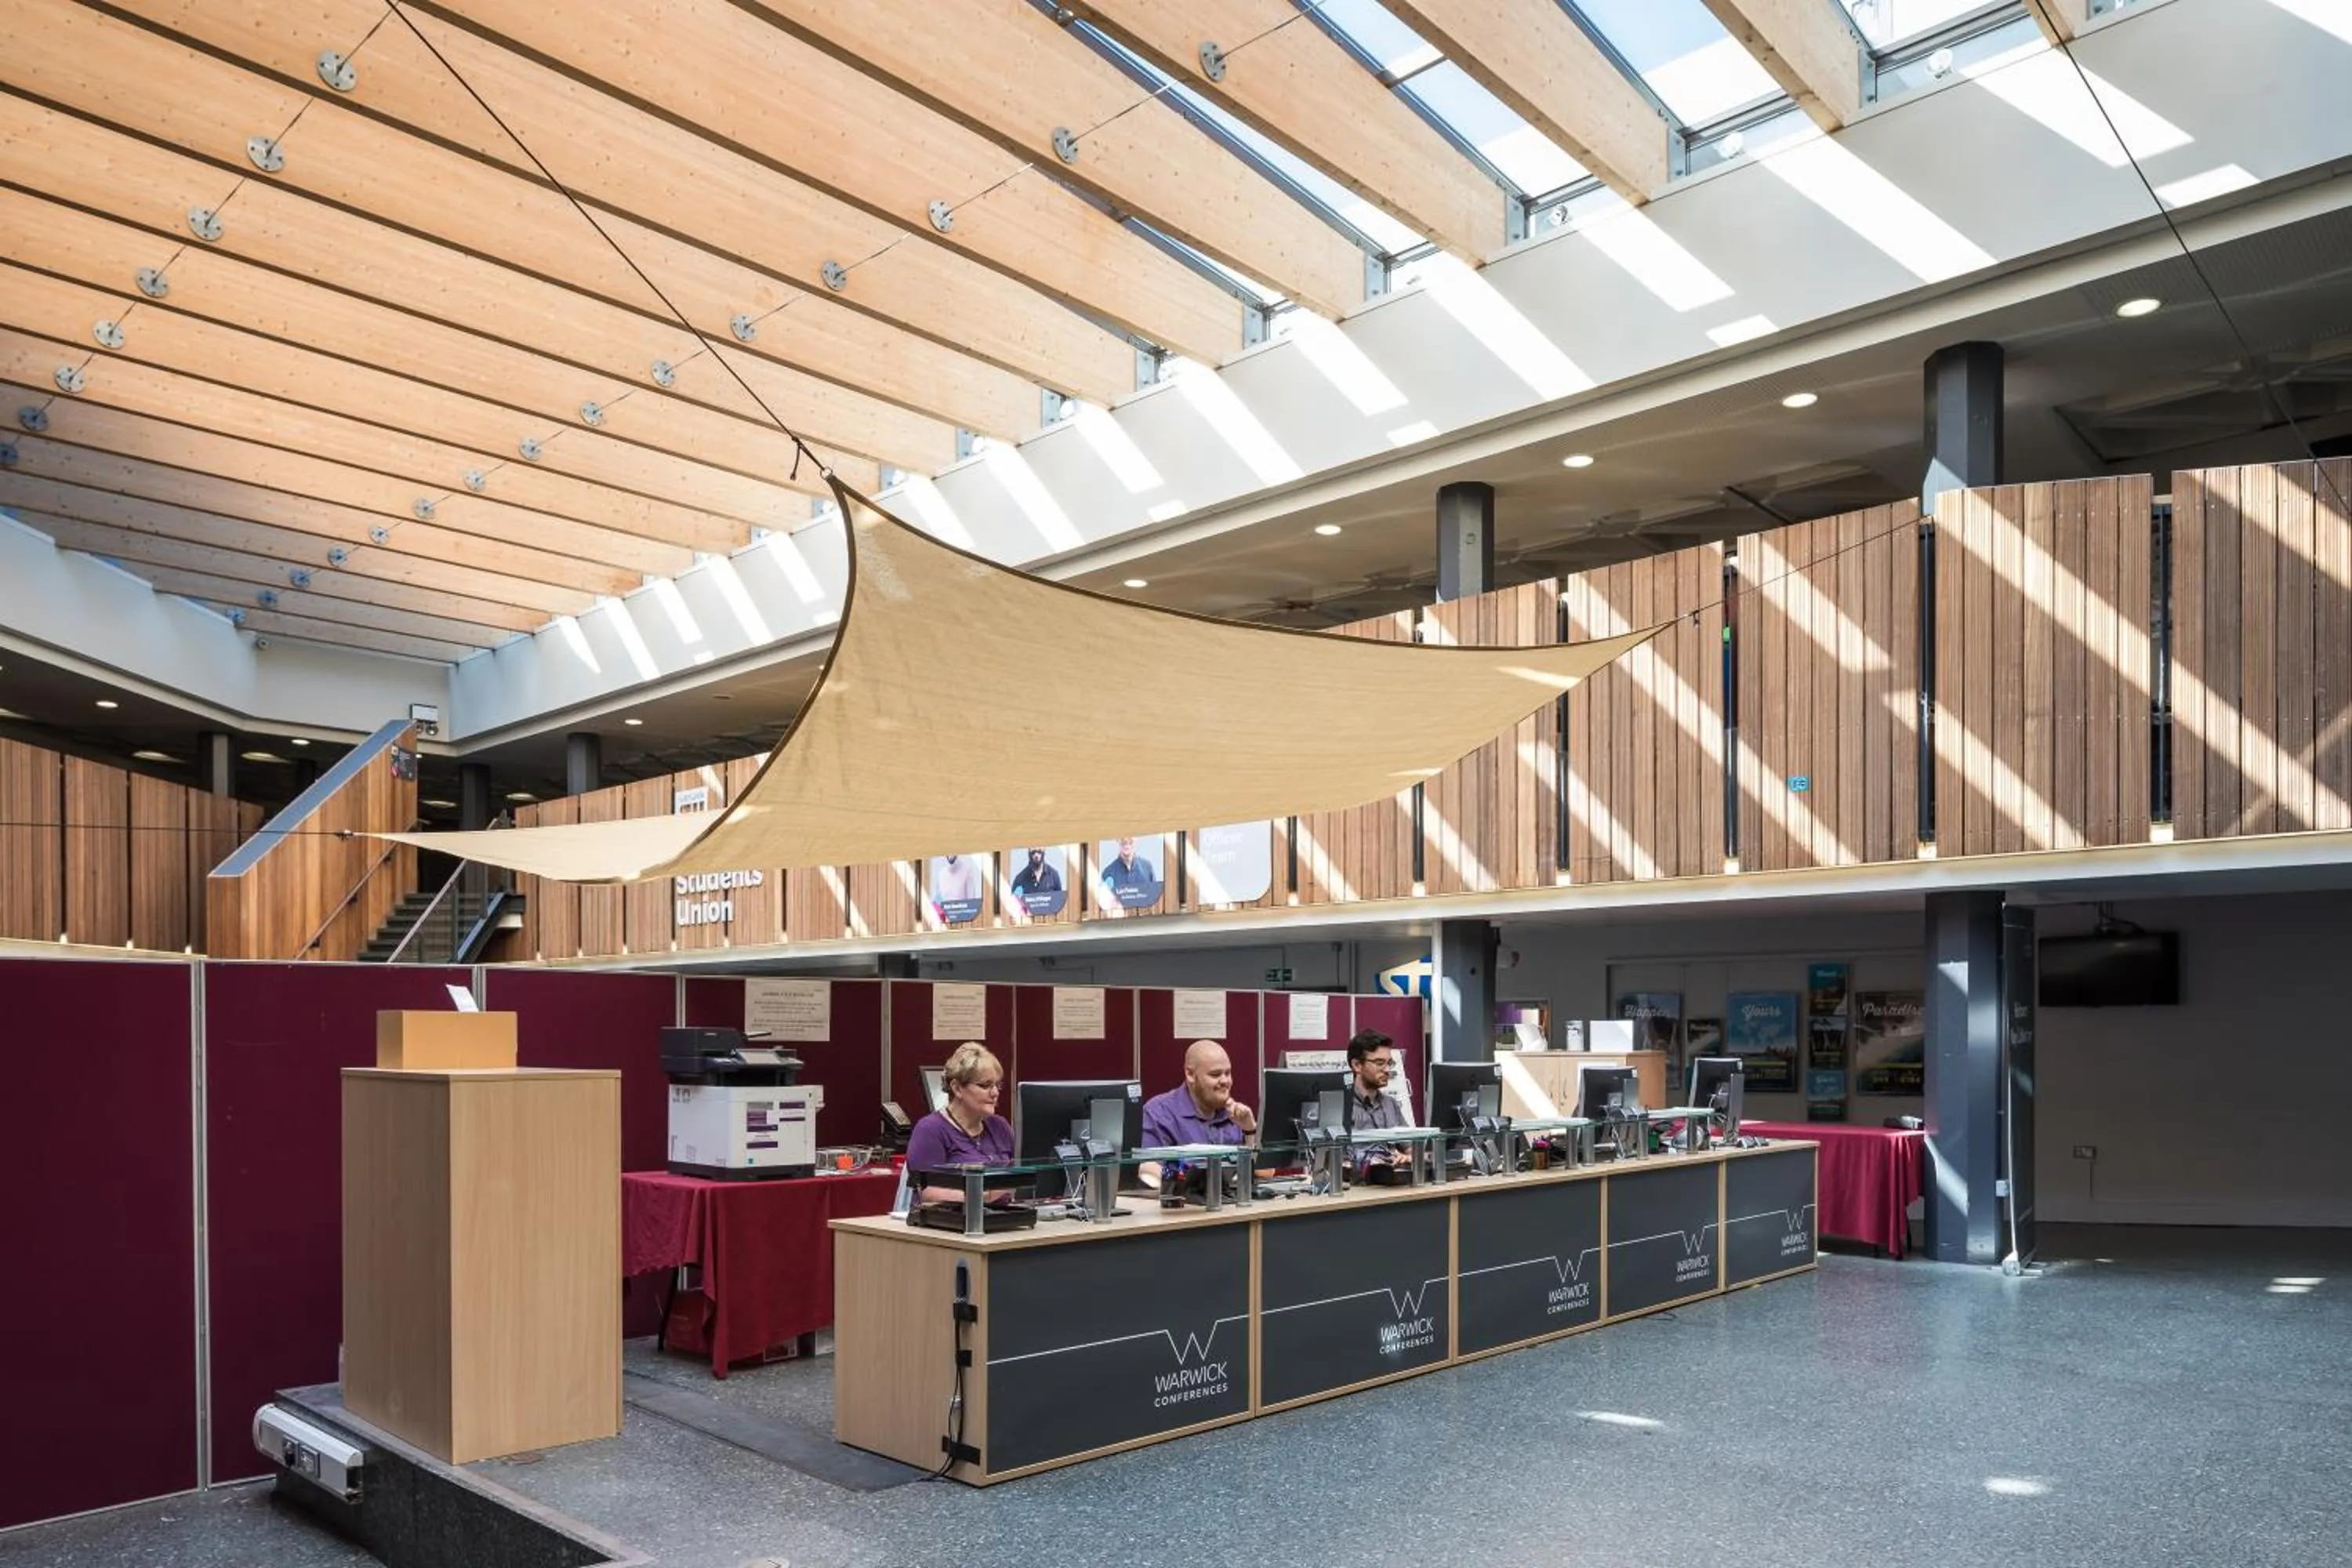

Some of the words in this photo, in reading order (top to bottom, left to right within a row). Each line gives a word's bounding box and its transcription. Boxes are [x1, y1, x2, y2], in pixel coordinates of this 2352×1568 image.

[677, 894, 734, 926] Union
[1548, 1282, 1589, 1303] WARWICK
[1381, 1316, 1434, 1342] WARWICK
[1380, 1333, 1434, 1355] CONFERENCES
[1155, 1361, 1228, 1392] WARWICK
[1154, 1382, 1229, 1407] CONFERENCES
